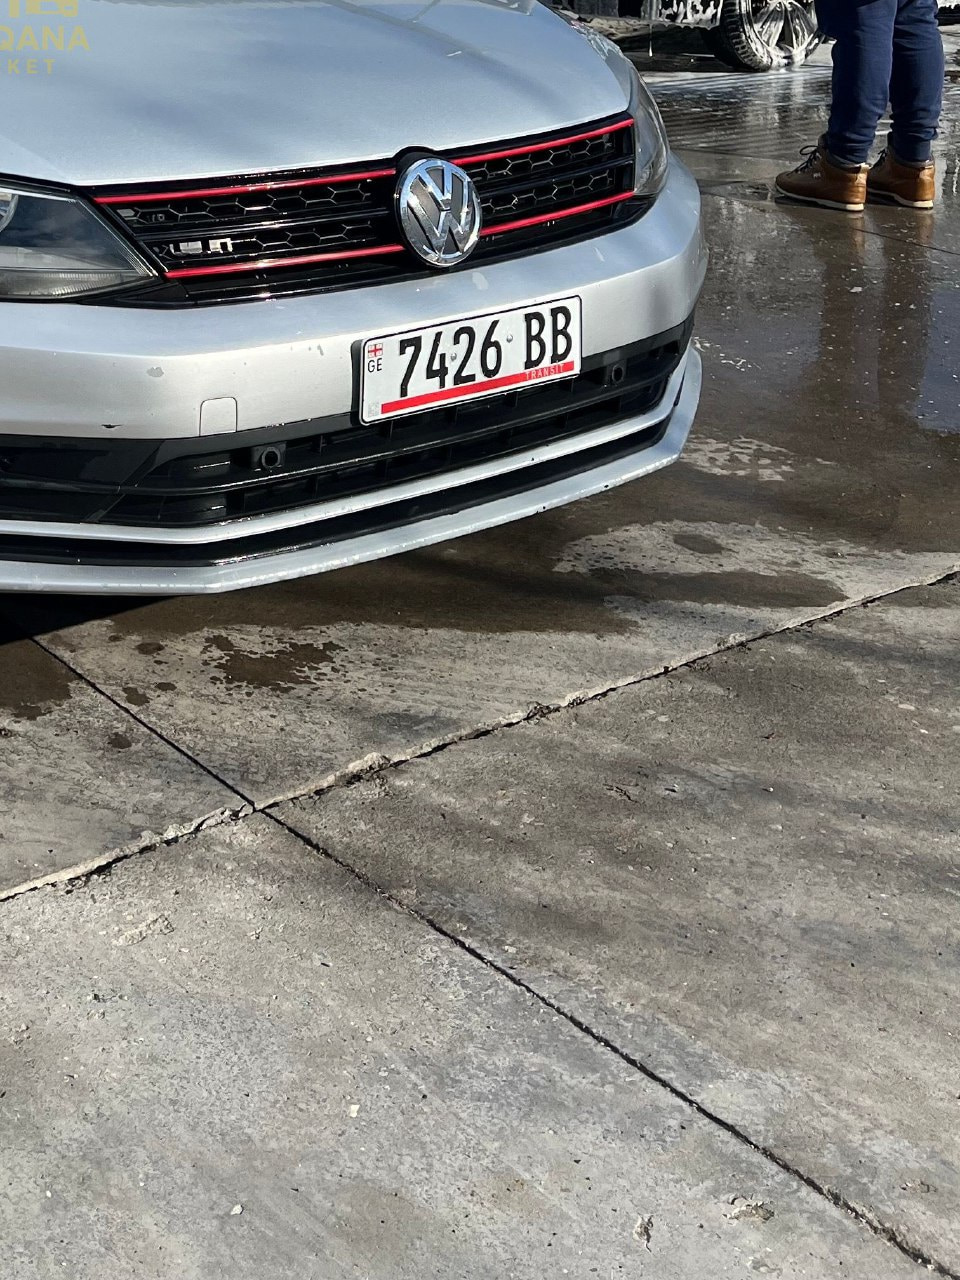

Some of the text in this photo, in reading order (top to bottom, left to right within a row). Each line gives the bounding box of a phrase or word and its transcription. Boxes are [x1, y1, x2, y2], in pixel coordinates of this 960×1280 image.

[367, 305, 573, 398] GE 7426 BB
[526, 363, 565, 381] TRANSIT
